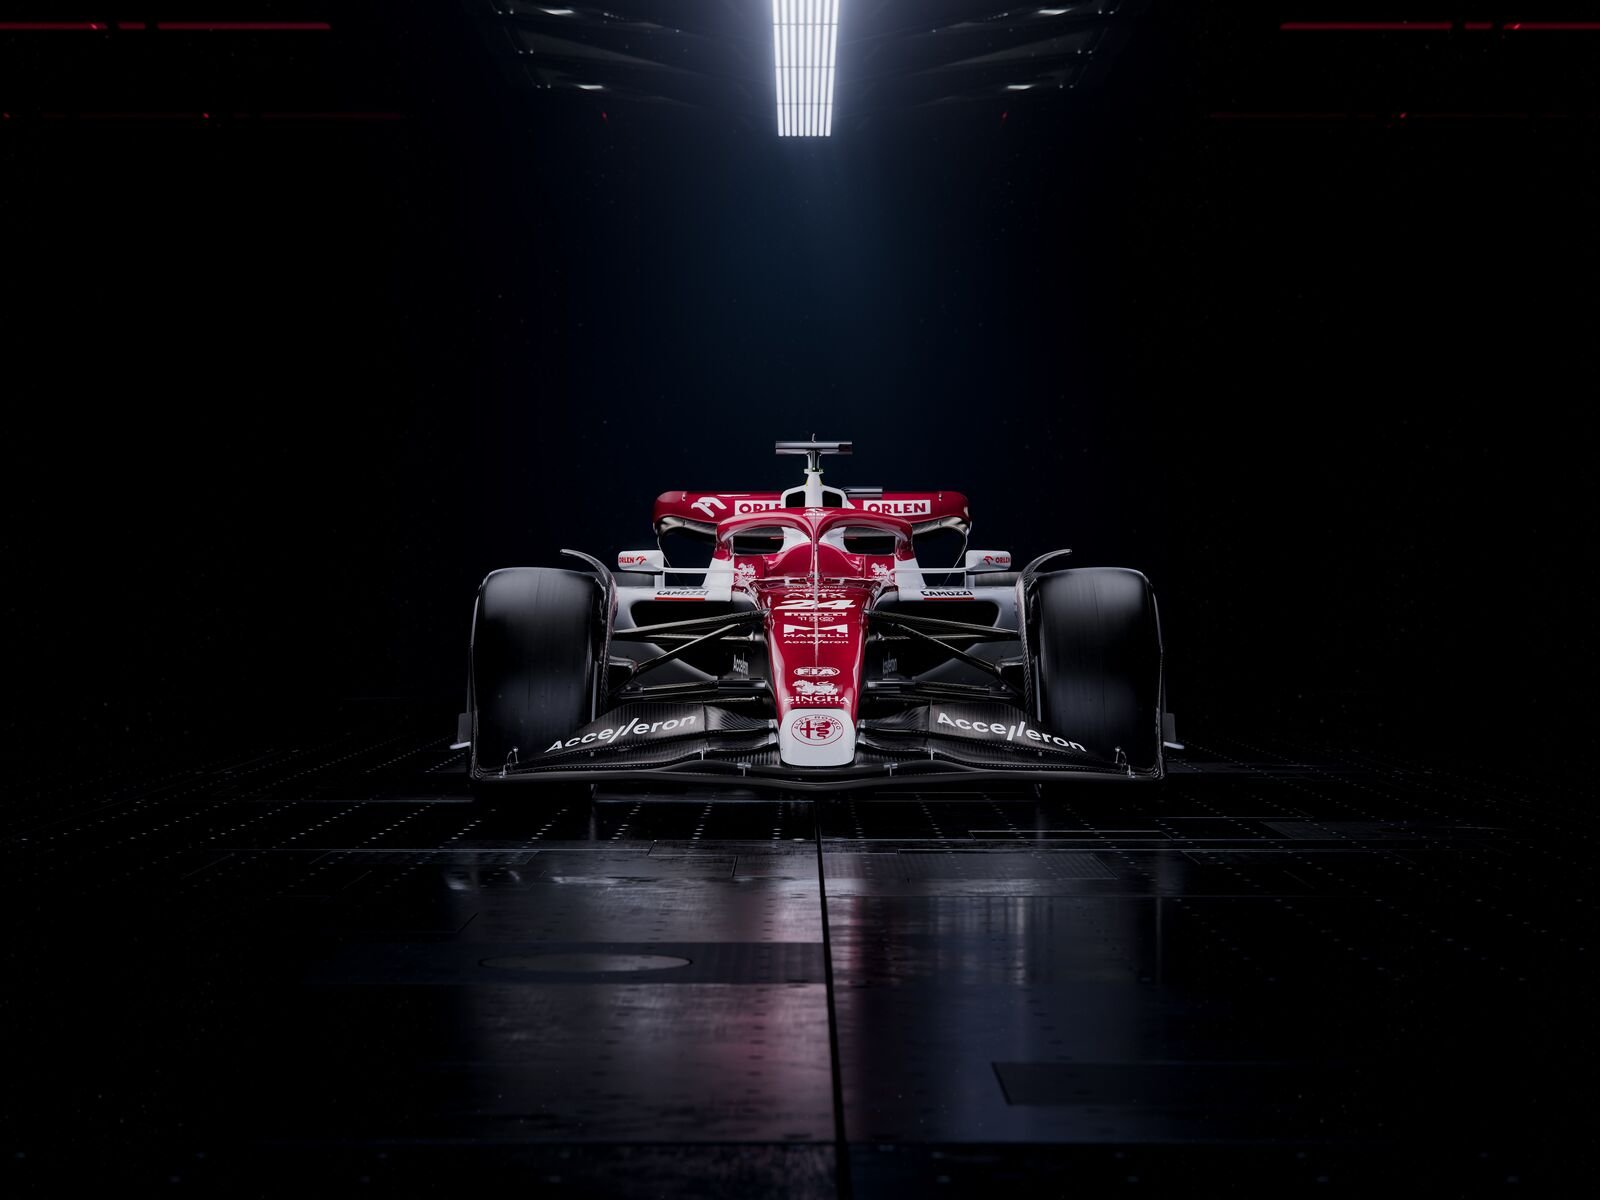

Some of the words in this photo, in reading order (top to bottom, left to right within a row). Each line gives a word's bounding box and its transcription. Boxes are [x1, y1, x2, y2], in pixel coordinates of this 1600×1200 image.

[739, 503, 781, 513] ORLE
[868, 503, 926, 514] ORLEN
[774, 600, 856, 609] 24
[784, 696, 849, 704] SINGHA
[544, 716, 697, 753] Accelleron
[937, 712, 1087, 752] Accelleron
